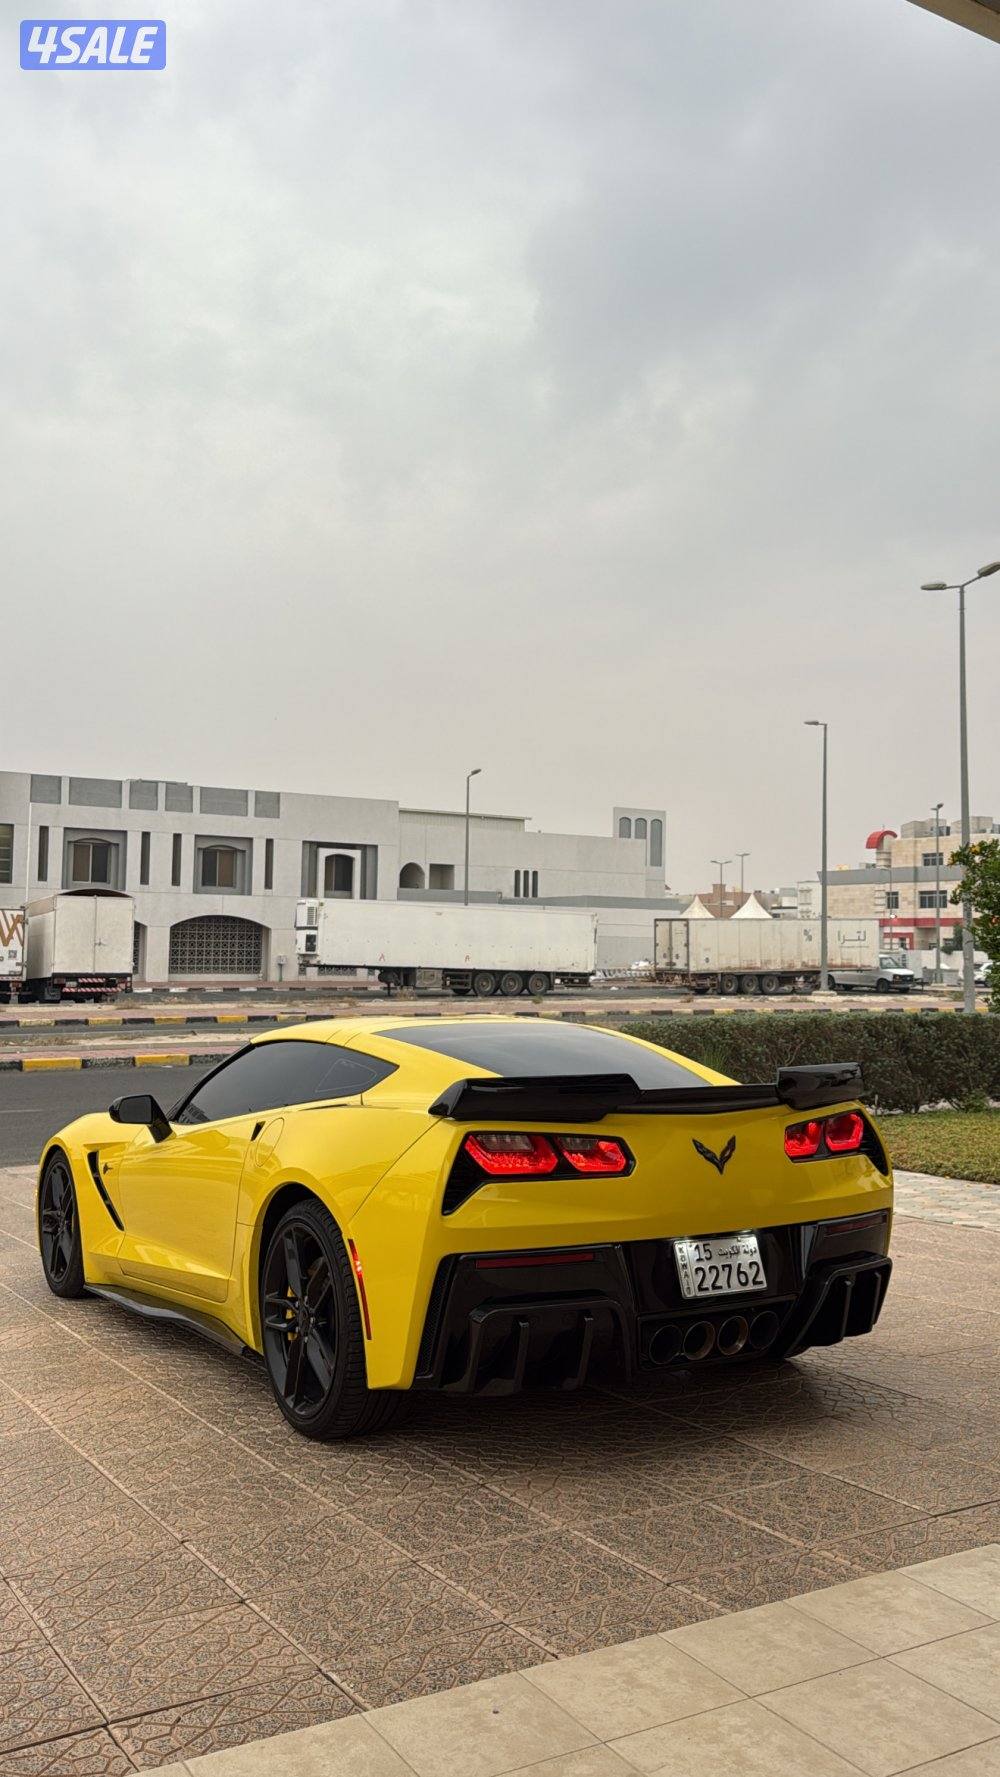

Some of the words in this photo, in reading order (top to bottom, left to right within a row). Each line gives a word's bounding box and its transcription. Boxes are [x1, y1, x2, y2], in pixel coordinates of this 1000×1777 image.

[694, 1243, 712, 1261] 15
[718, 1244, 740, 1258] الكويت
[742, 1244, 757, 1256] دولة
[694, 1261, 764, 1292] 22762
